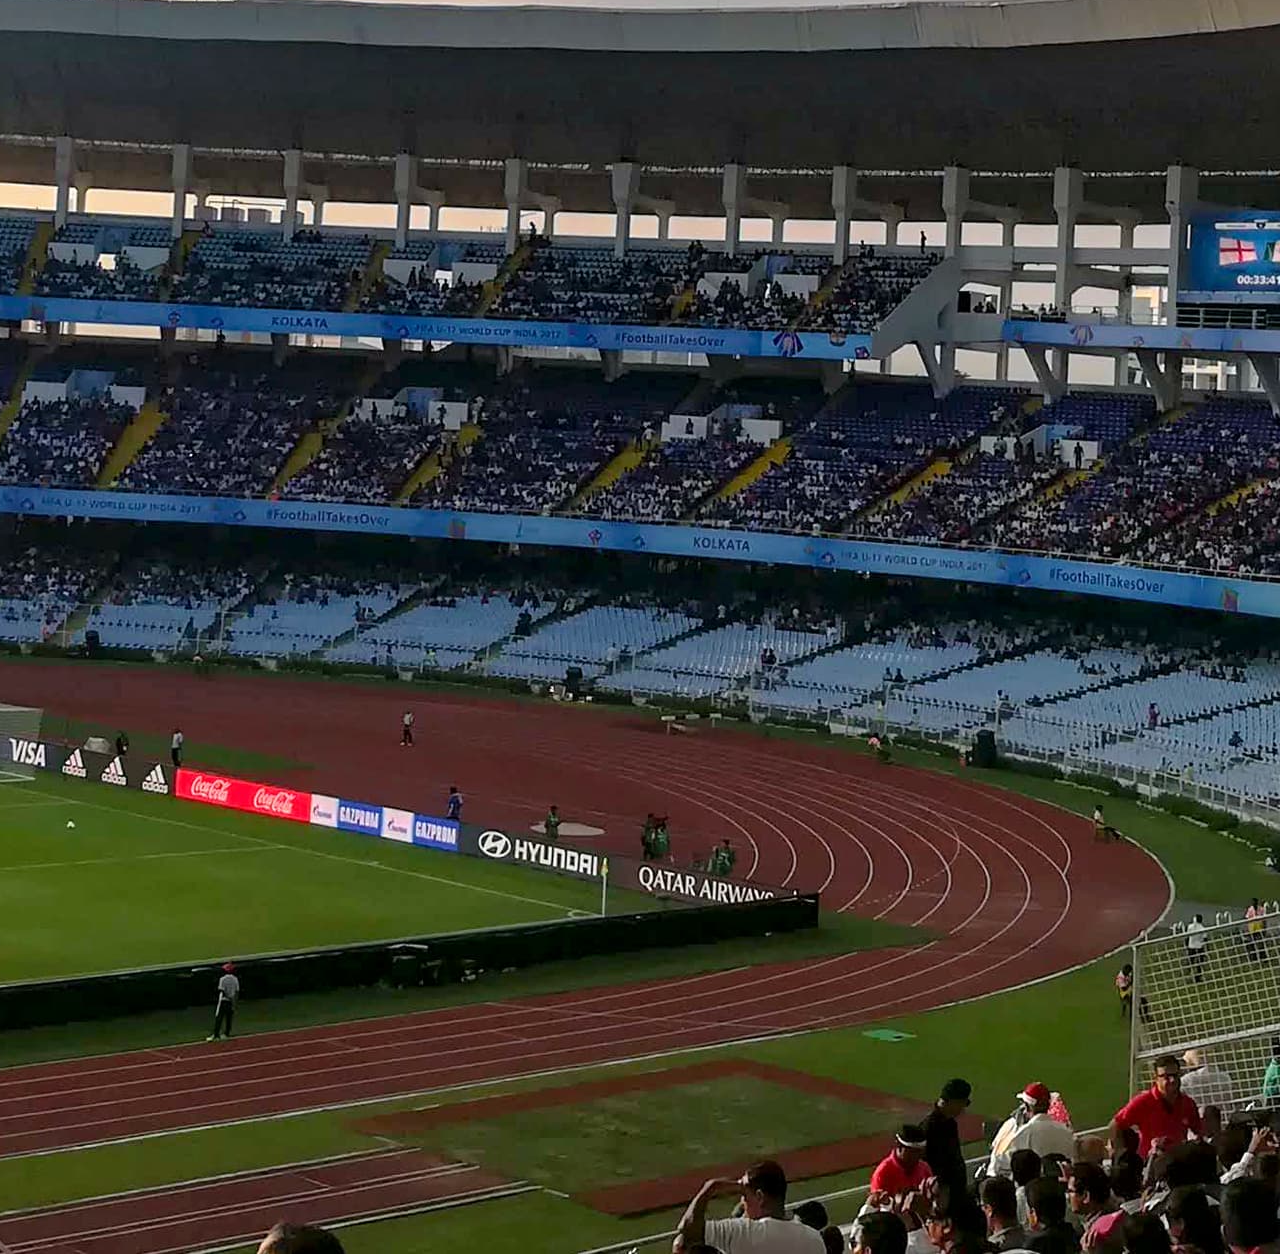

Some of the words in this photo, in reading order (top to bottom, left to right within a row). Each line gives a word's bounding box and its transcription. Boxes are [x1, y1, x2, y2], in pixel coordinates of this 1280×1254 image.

[271, 316, 329, 329] KOLKATA
[615, 332, 725, 347] #FootballTakesOver
[266, 508, 390, 526] #FootballTakesOver
[693, 536, 750, 553] KOLKATA
[1049, 567, 1165, 593] #FootballTakesOver
[9, 737, 46, 767] VISA
[62, 764, 87, 778] adidas
[101, 772, 127, 786] adidas
[142, 780, 169, 795] adidas
[340, 806, 380, 829] GAZPROM
[415, 820, 457, 845] GAZPROM
[514, 838, 598, 877] HYUNDAI
[638, 866, 696, 897] QATAR
